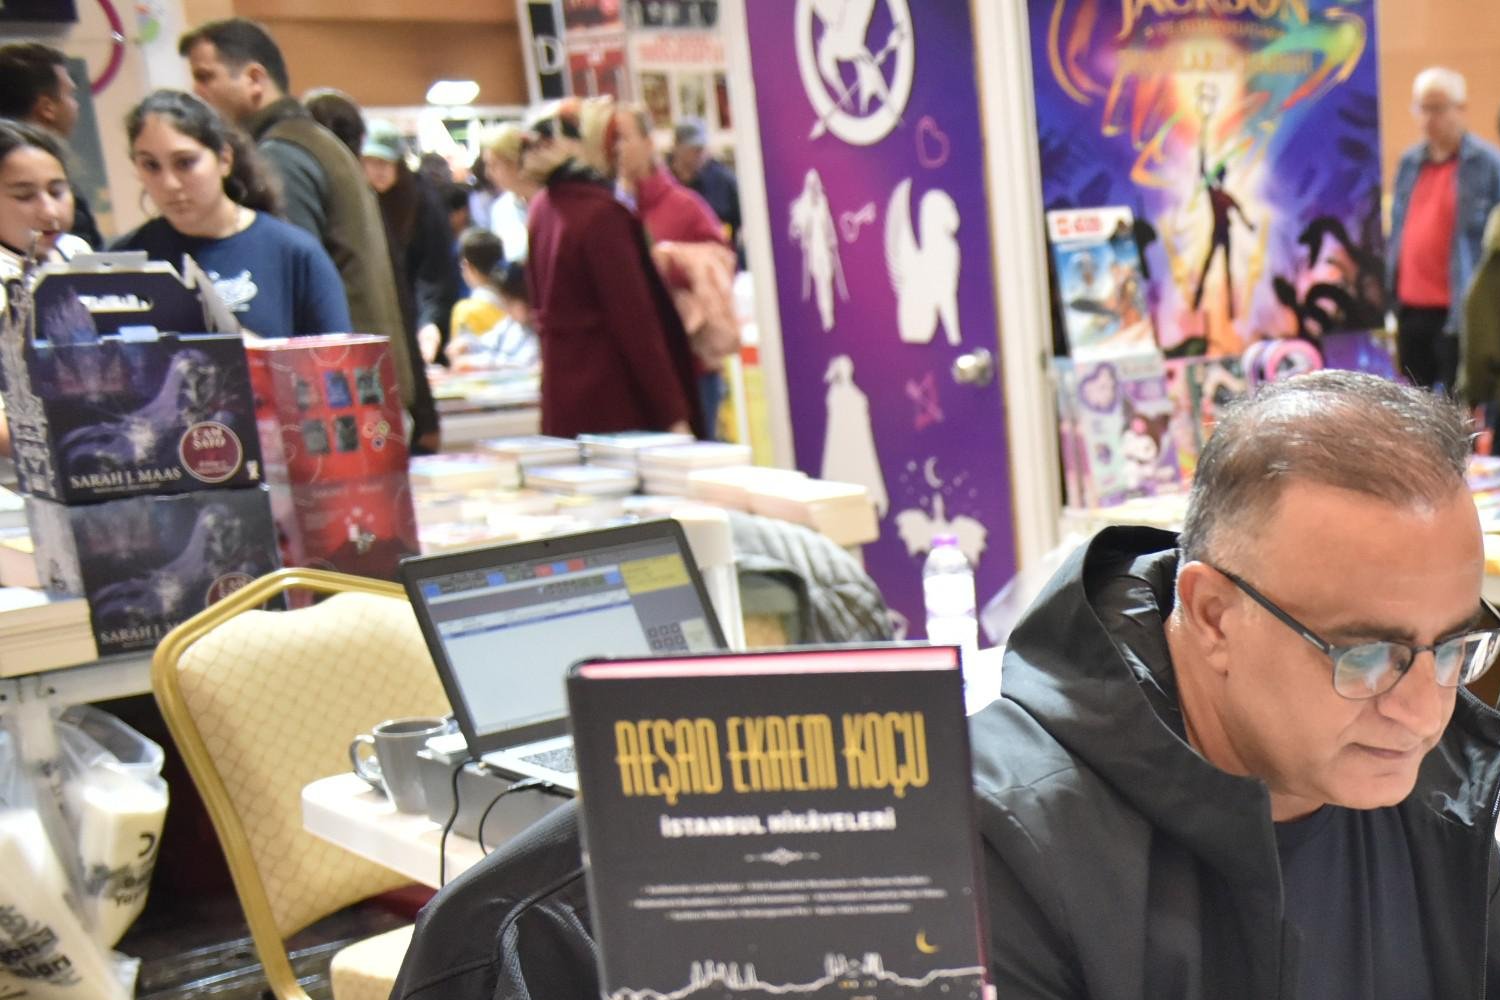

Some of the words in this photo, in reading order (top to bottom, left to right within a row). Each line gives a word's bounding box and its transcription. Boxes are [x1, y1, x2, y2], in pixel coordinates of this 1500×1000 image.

[69, 471, 124, 491] SARAH
[137, 467, 183, 486] MAAS
[101, 625, 151, 645] SARAH
[615, 717, 724, 805] REŞAD
[726, 713, 838, 793] EKREM
[842, 710, 930, 798] KOÇU
[660, 809, 767, 838] İSTANBUL
